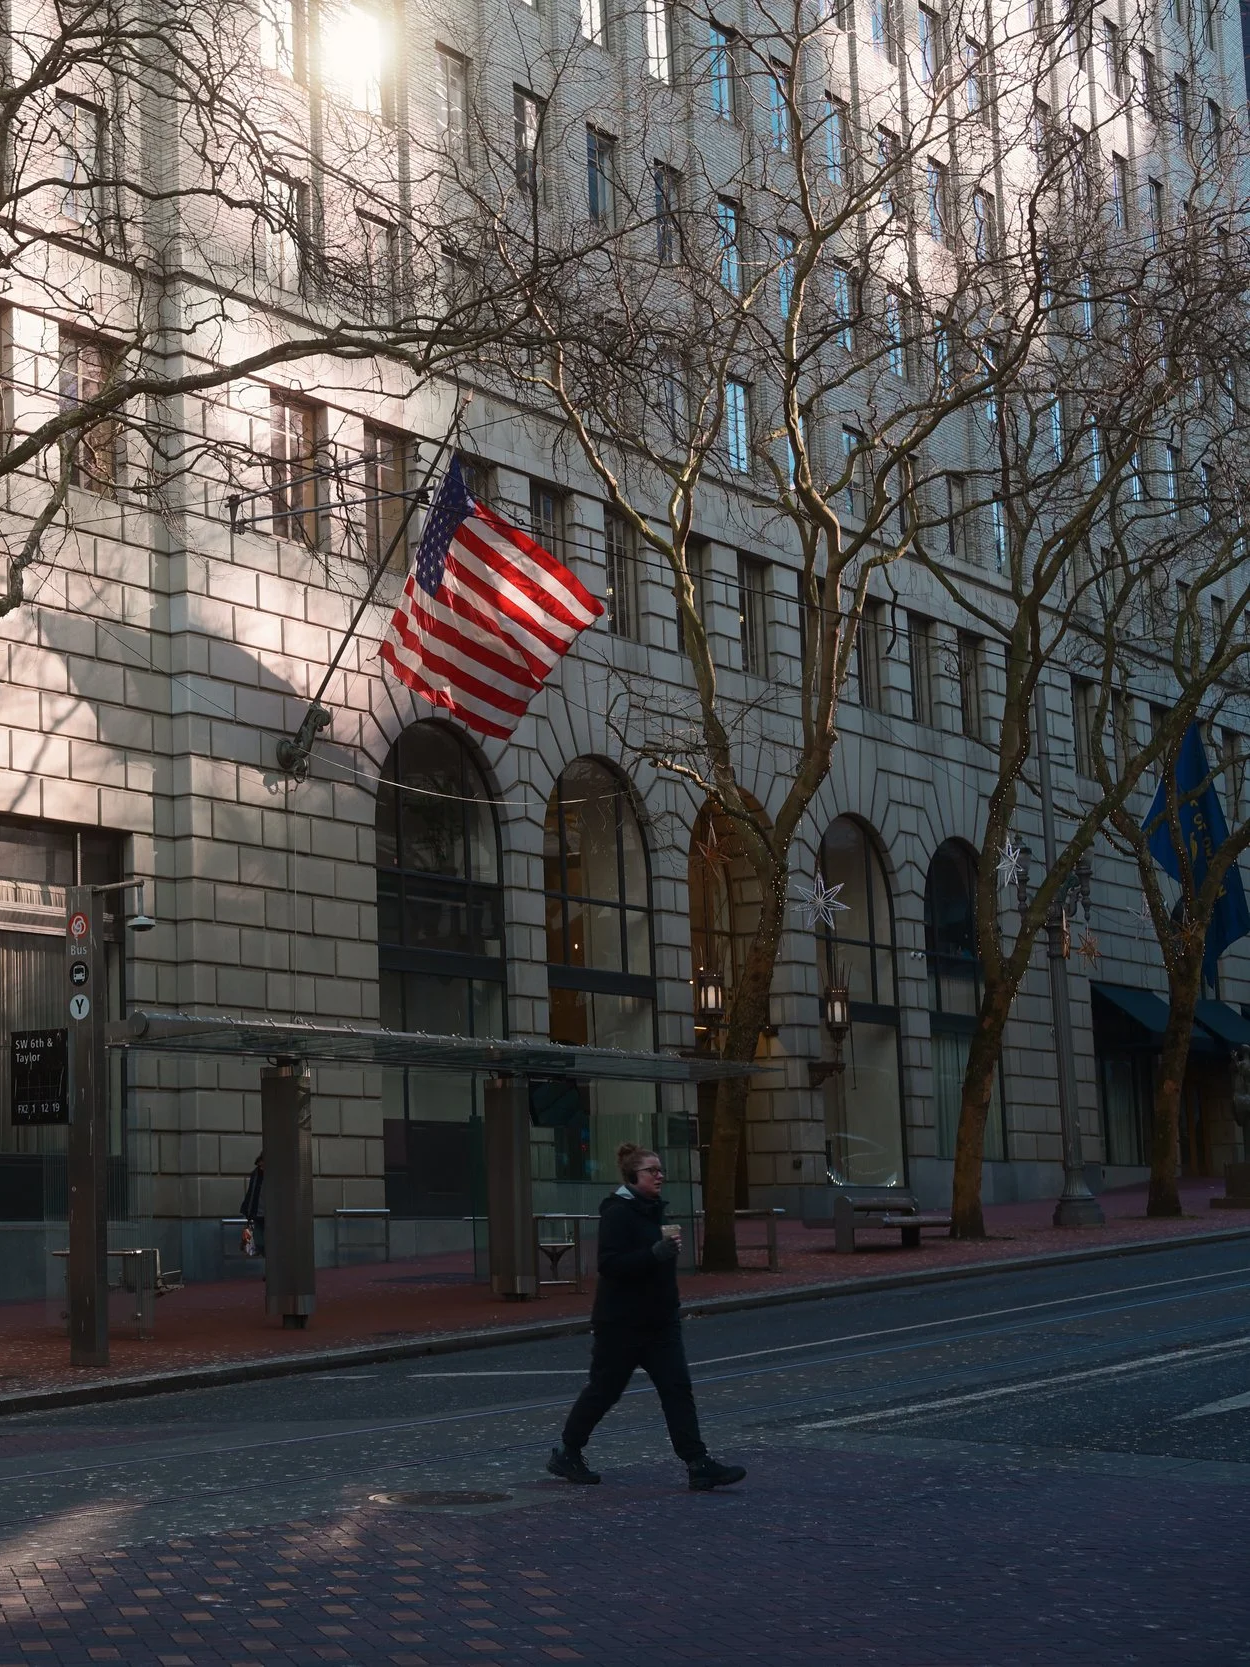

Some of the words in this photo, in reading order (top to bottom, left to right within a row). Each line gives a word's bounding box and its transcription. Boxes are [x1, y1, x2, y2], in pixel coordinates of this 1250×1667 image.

[70, 945, 87, 955] Bus
[75, 998, 85, 1015] Y
[15, 1039, 28, 1050] SW
[30, 1037, 45, 1049] 6th
[46, 1037, 54, 1047] &
[15, 1051, 40, 1065] Taylor
[17, 1104, 29, 1114] FX2
[31, 1103, 36, 1114] 1
[41, 1102, 49, 1113] 12
[52, 1102, 60, 1113] 19
